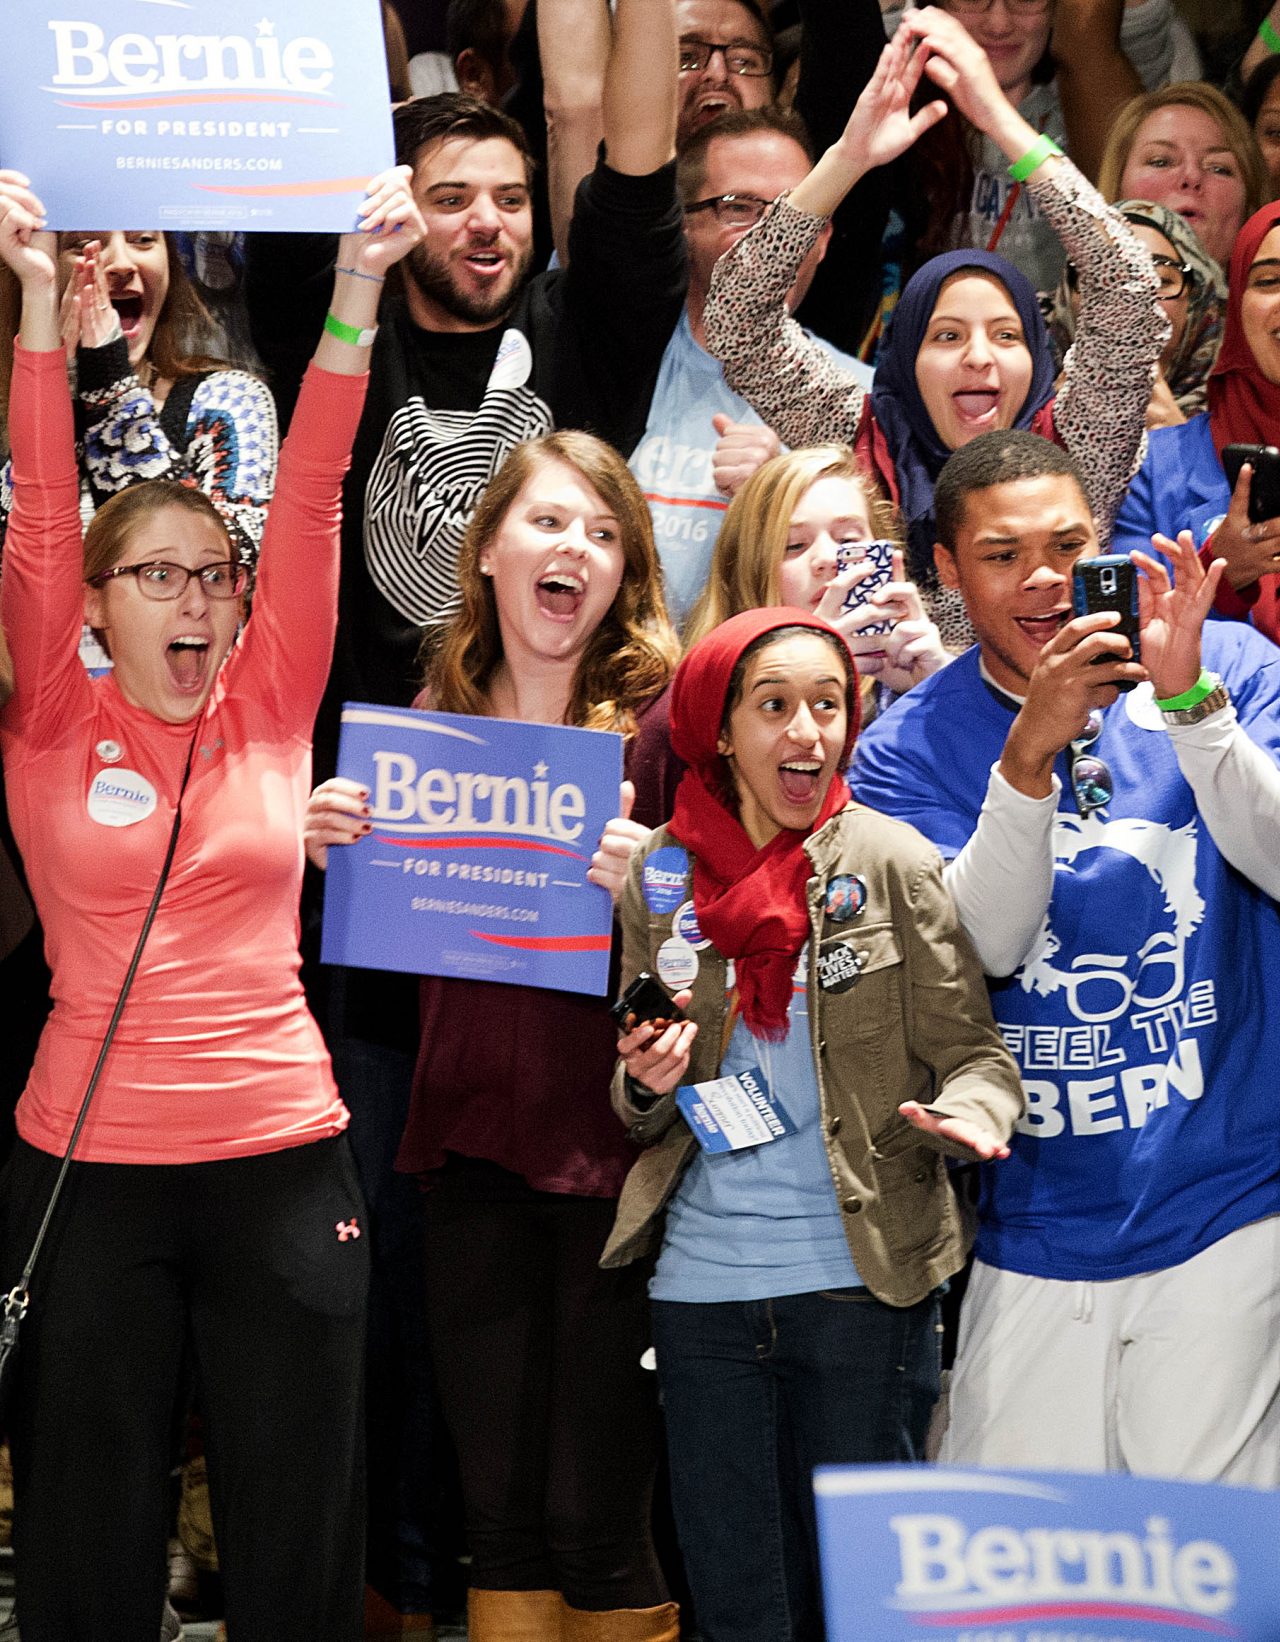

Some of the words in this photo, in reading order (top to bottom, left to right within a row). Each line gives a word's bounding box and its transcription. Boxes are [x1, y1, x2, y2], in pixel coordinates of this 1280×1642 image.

[48, 17, 334, 91] Bernie
[102, 119, 148, 136] FOR
[157, 120, 291, 138] PRESIDENT
[115, 156, 284, 171] BERNIESANDERS.COM
[653, 510, 708, 541] 2016
[94, 780, 150, 805] Bernie
[372, 751, 586, 841] Bernie
[402, 857, 441, 877] FOR
[446, 861, 550, 888] PRESIDENT
[644, 866, 687, 885] Berni
[410, 896, 540, 923] BERNIESANDERS.COM
[821, 955, 855, 979] LIVES
[822, 966, 859, 988] MATTER
[738, 1071, 786, 1136] VOLUNTEER
[888, 1514, 1239, 1617] Bernie
